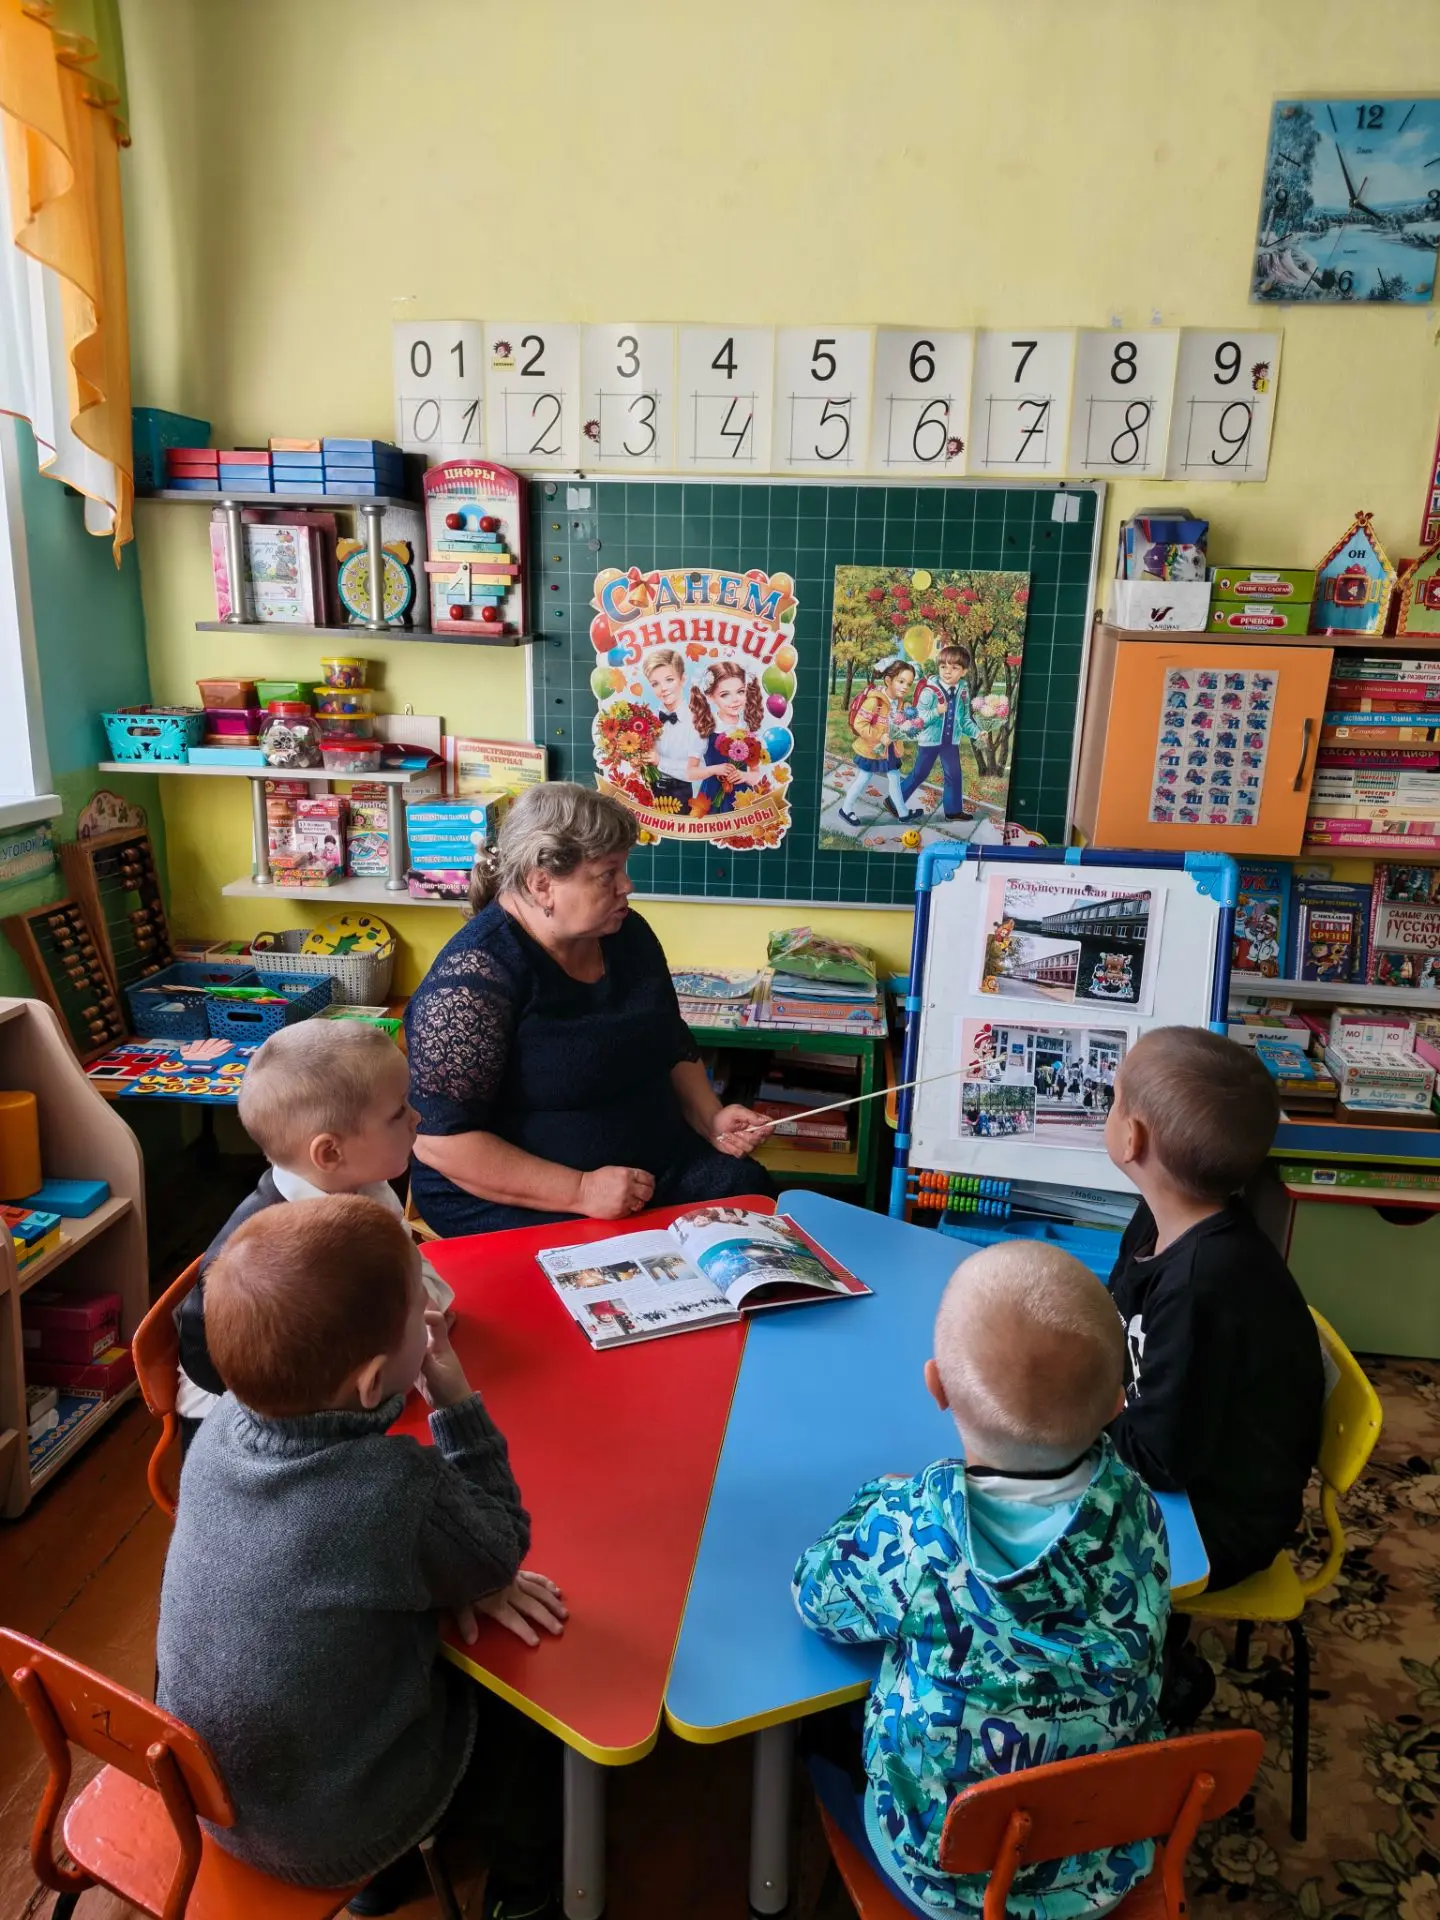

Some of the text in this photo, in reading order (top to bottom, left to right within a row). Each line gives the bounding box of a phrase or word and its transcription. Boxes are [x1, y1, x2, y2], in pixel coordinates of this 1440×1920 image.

[1356, 104, 1384, 130] 12
[1275, 188, 1440, 212] 9 3
[1338, 270, 1354, 293] 6
[410, 334, 1242, 385] 0 1 2 3 4 5 6 7 8 9
[414, 394, 1253, 465] 0 1 2 3 4 5 6 7 8 9
[443, 467, 497, 482] ЦИФРЫ
[1348, 549, 1366, 559] ОН
[602, 573, 784, 623] С ДНЕМ
[1240, 617, 1274, 625] РЕЧЕВОЙ
[1359, 749, 1388, 757] БУКВ
[1402, 750, 1435, 758] ЦИФР
[677, 821, 686, 833] и
[687, 819, 732, 834] легкой
[733, 807, 775, 830] учебы
[1388, 909, 1423, 920] САМЫЕ
[1311, 921, 1351, 931] СТИХИ
[1345, 1030, 1361, 1038] МО
[1386, 1033, 1400, 1041] КО
[1368, 1089, 1407, 1100] Азбука
